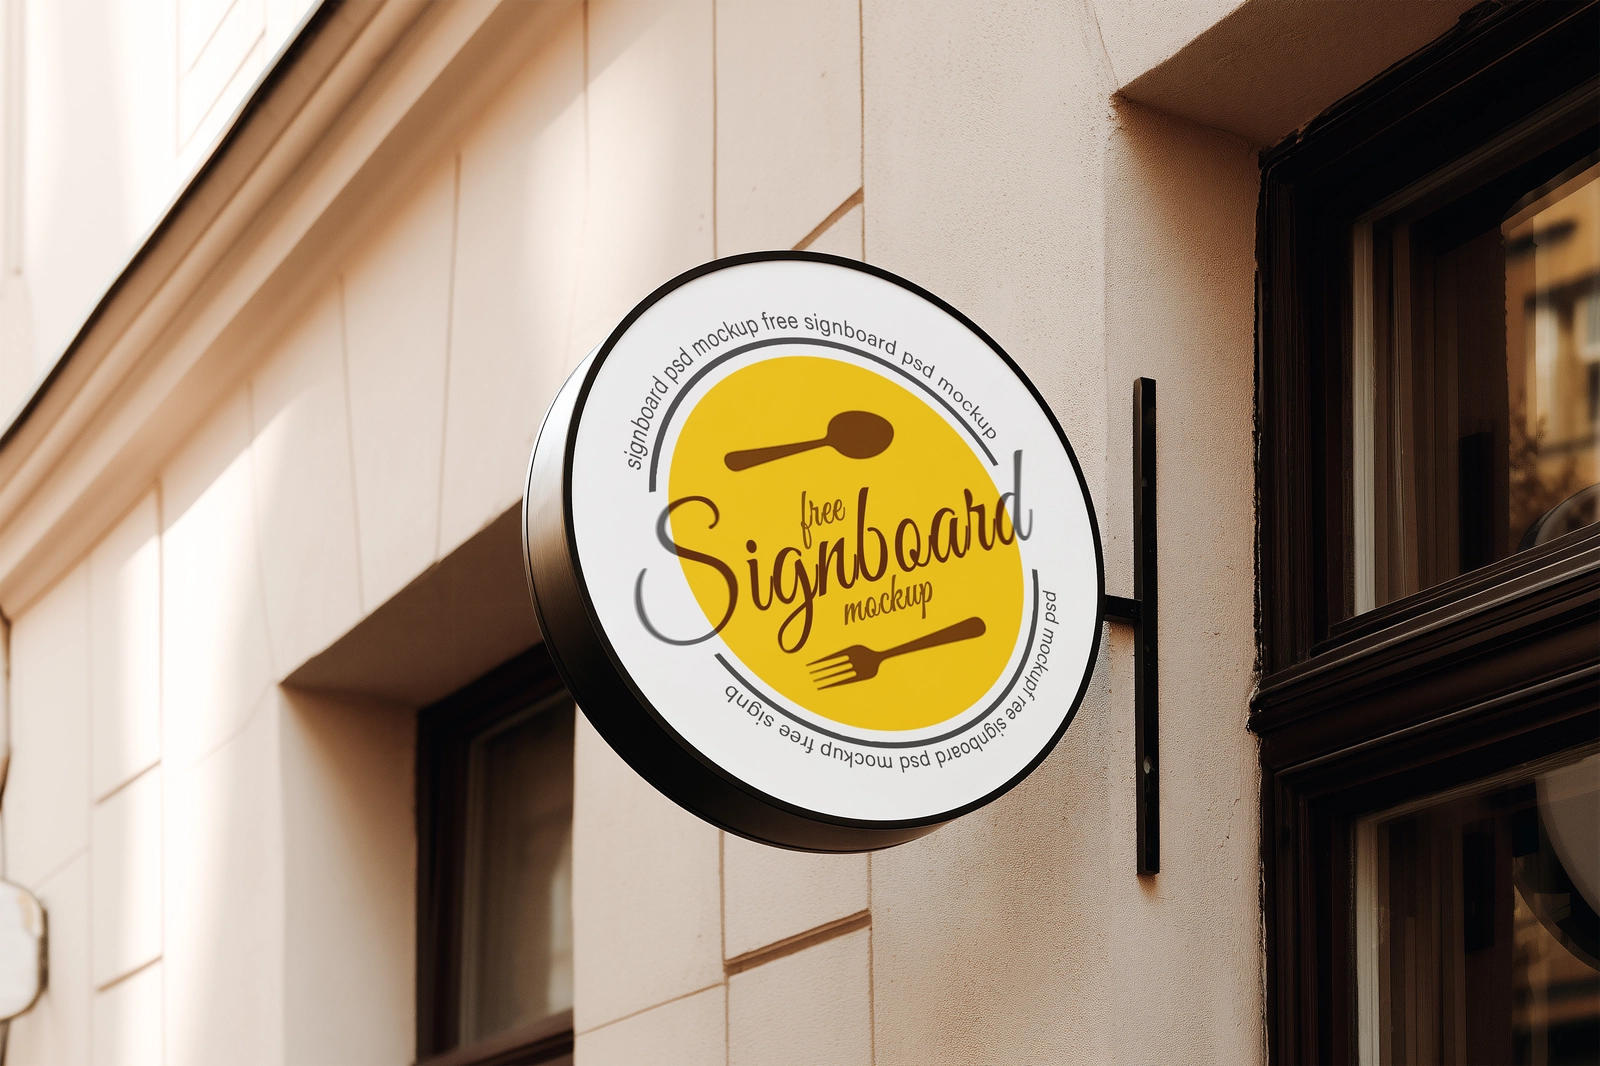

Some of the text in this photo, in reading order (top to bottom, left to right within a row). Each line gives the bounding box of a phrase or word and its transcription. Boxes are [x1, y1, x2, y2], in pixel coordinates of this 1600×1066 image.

[623, 311, 997, 471] signboard psd mockup free signboard psd mockup
[800, 490, 846, 550] free
[633, 449, 1034, 654] Signboard
[843, 574, 933, 626] mockup
[1042, 589, 1060, 625] psd
[725, 685, 775, 728] signb
[779, 724, 814, 754] free
[820, 741, 893, 769] mockup
[899, 749, 931, 774] psd
[934, 717, 1007, 769] signboard
